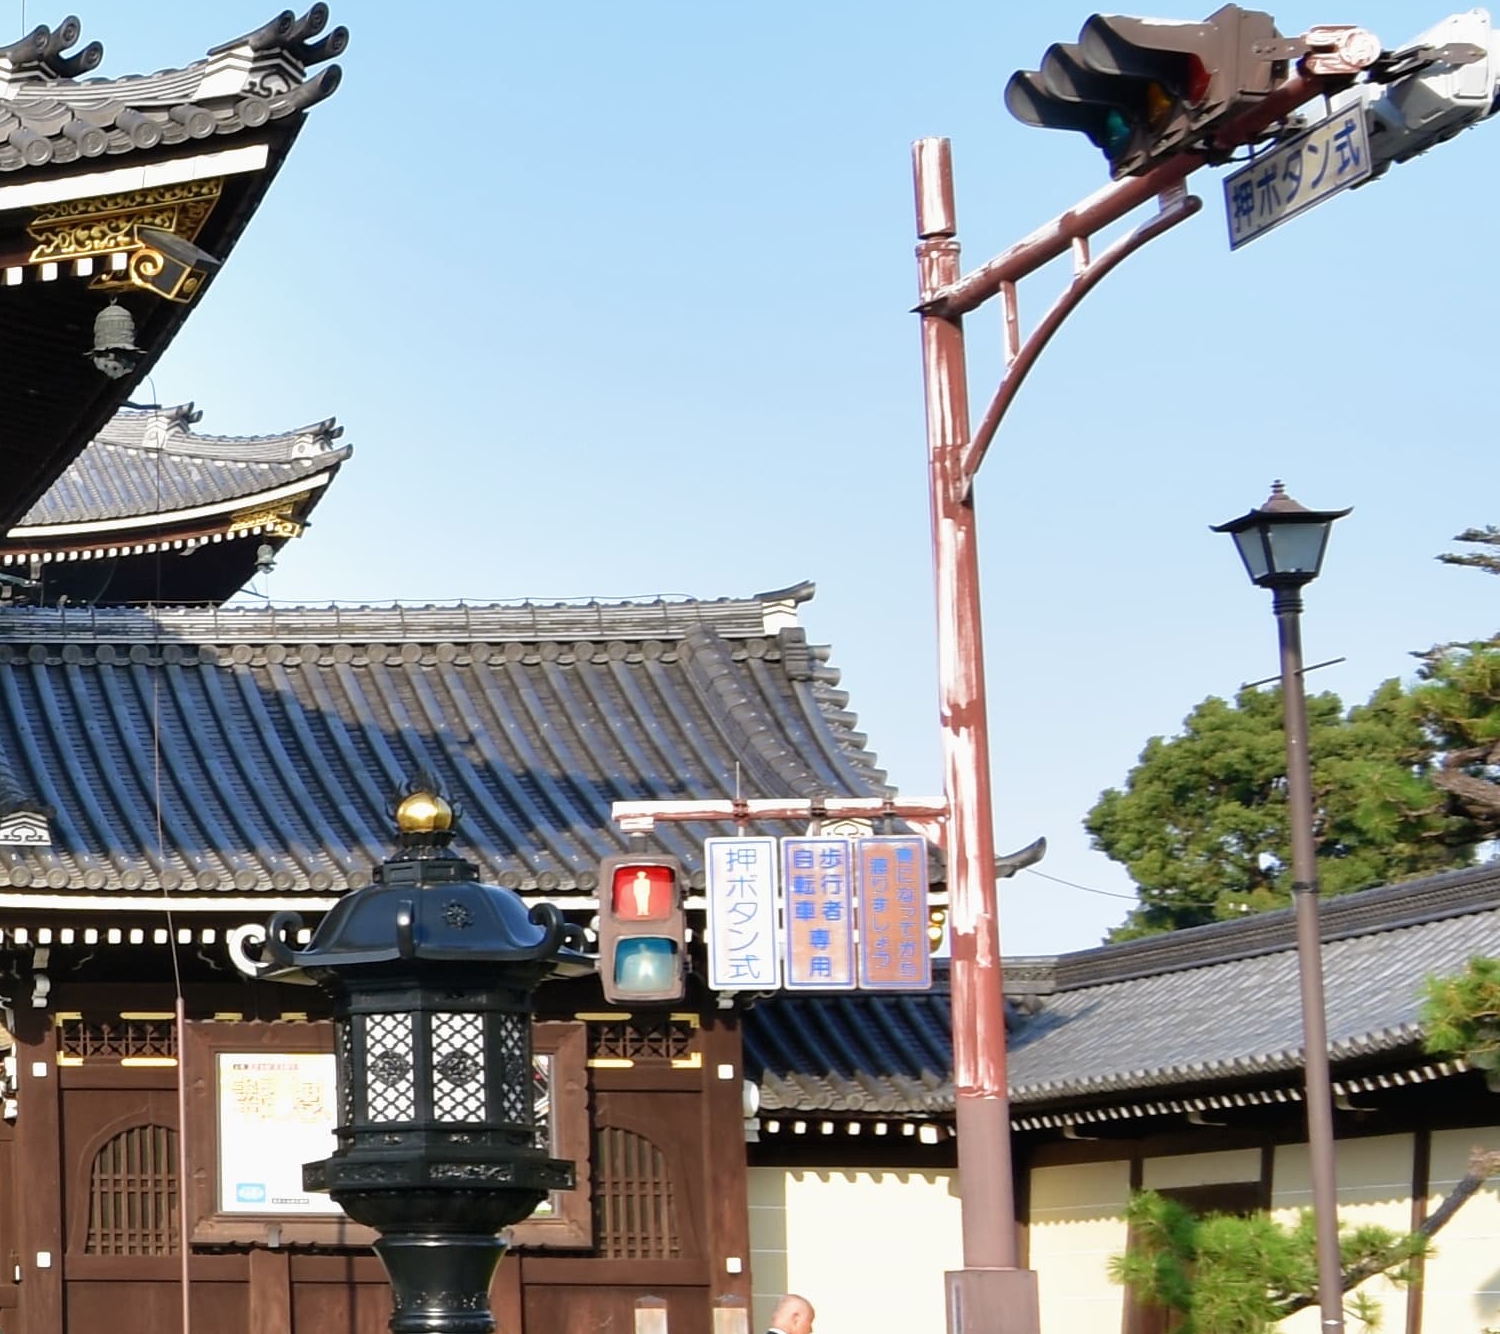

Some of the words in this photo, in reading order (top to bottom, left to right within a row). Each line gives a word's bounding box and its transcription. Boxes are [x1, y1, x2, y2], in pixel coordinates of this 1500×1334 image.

[1232, 118, 1361, 233] 押ボタン式
[725, 847, 761, 979] 押ボタン式
[793, 848, 816, 921] 自転車
[819, 847, 844, 921] 歩行者
[808, 928, 832, 978] 専用
